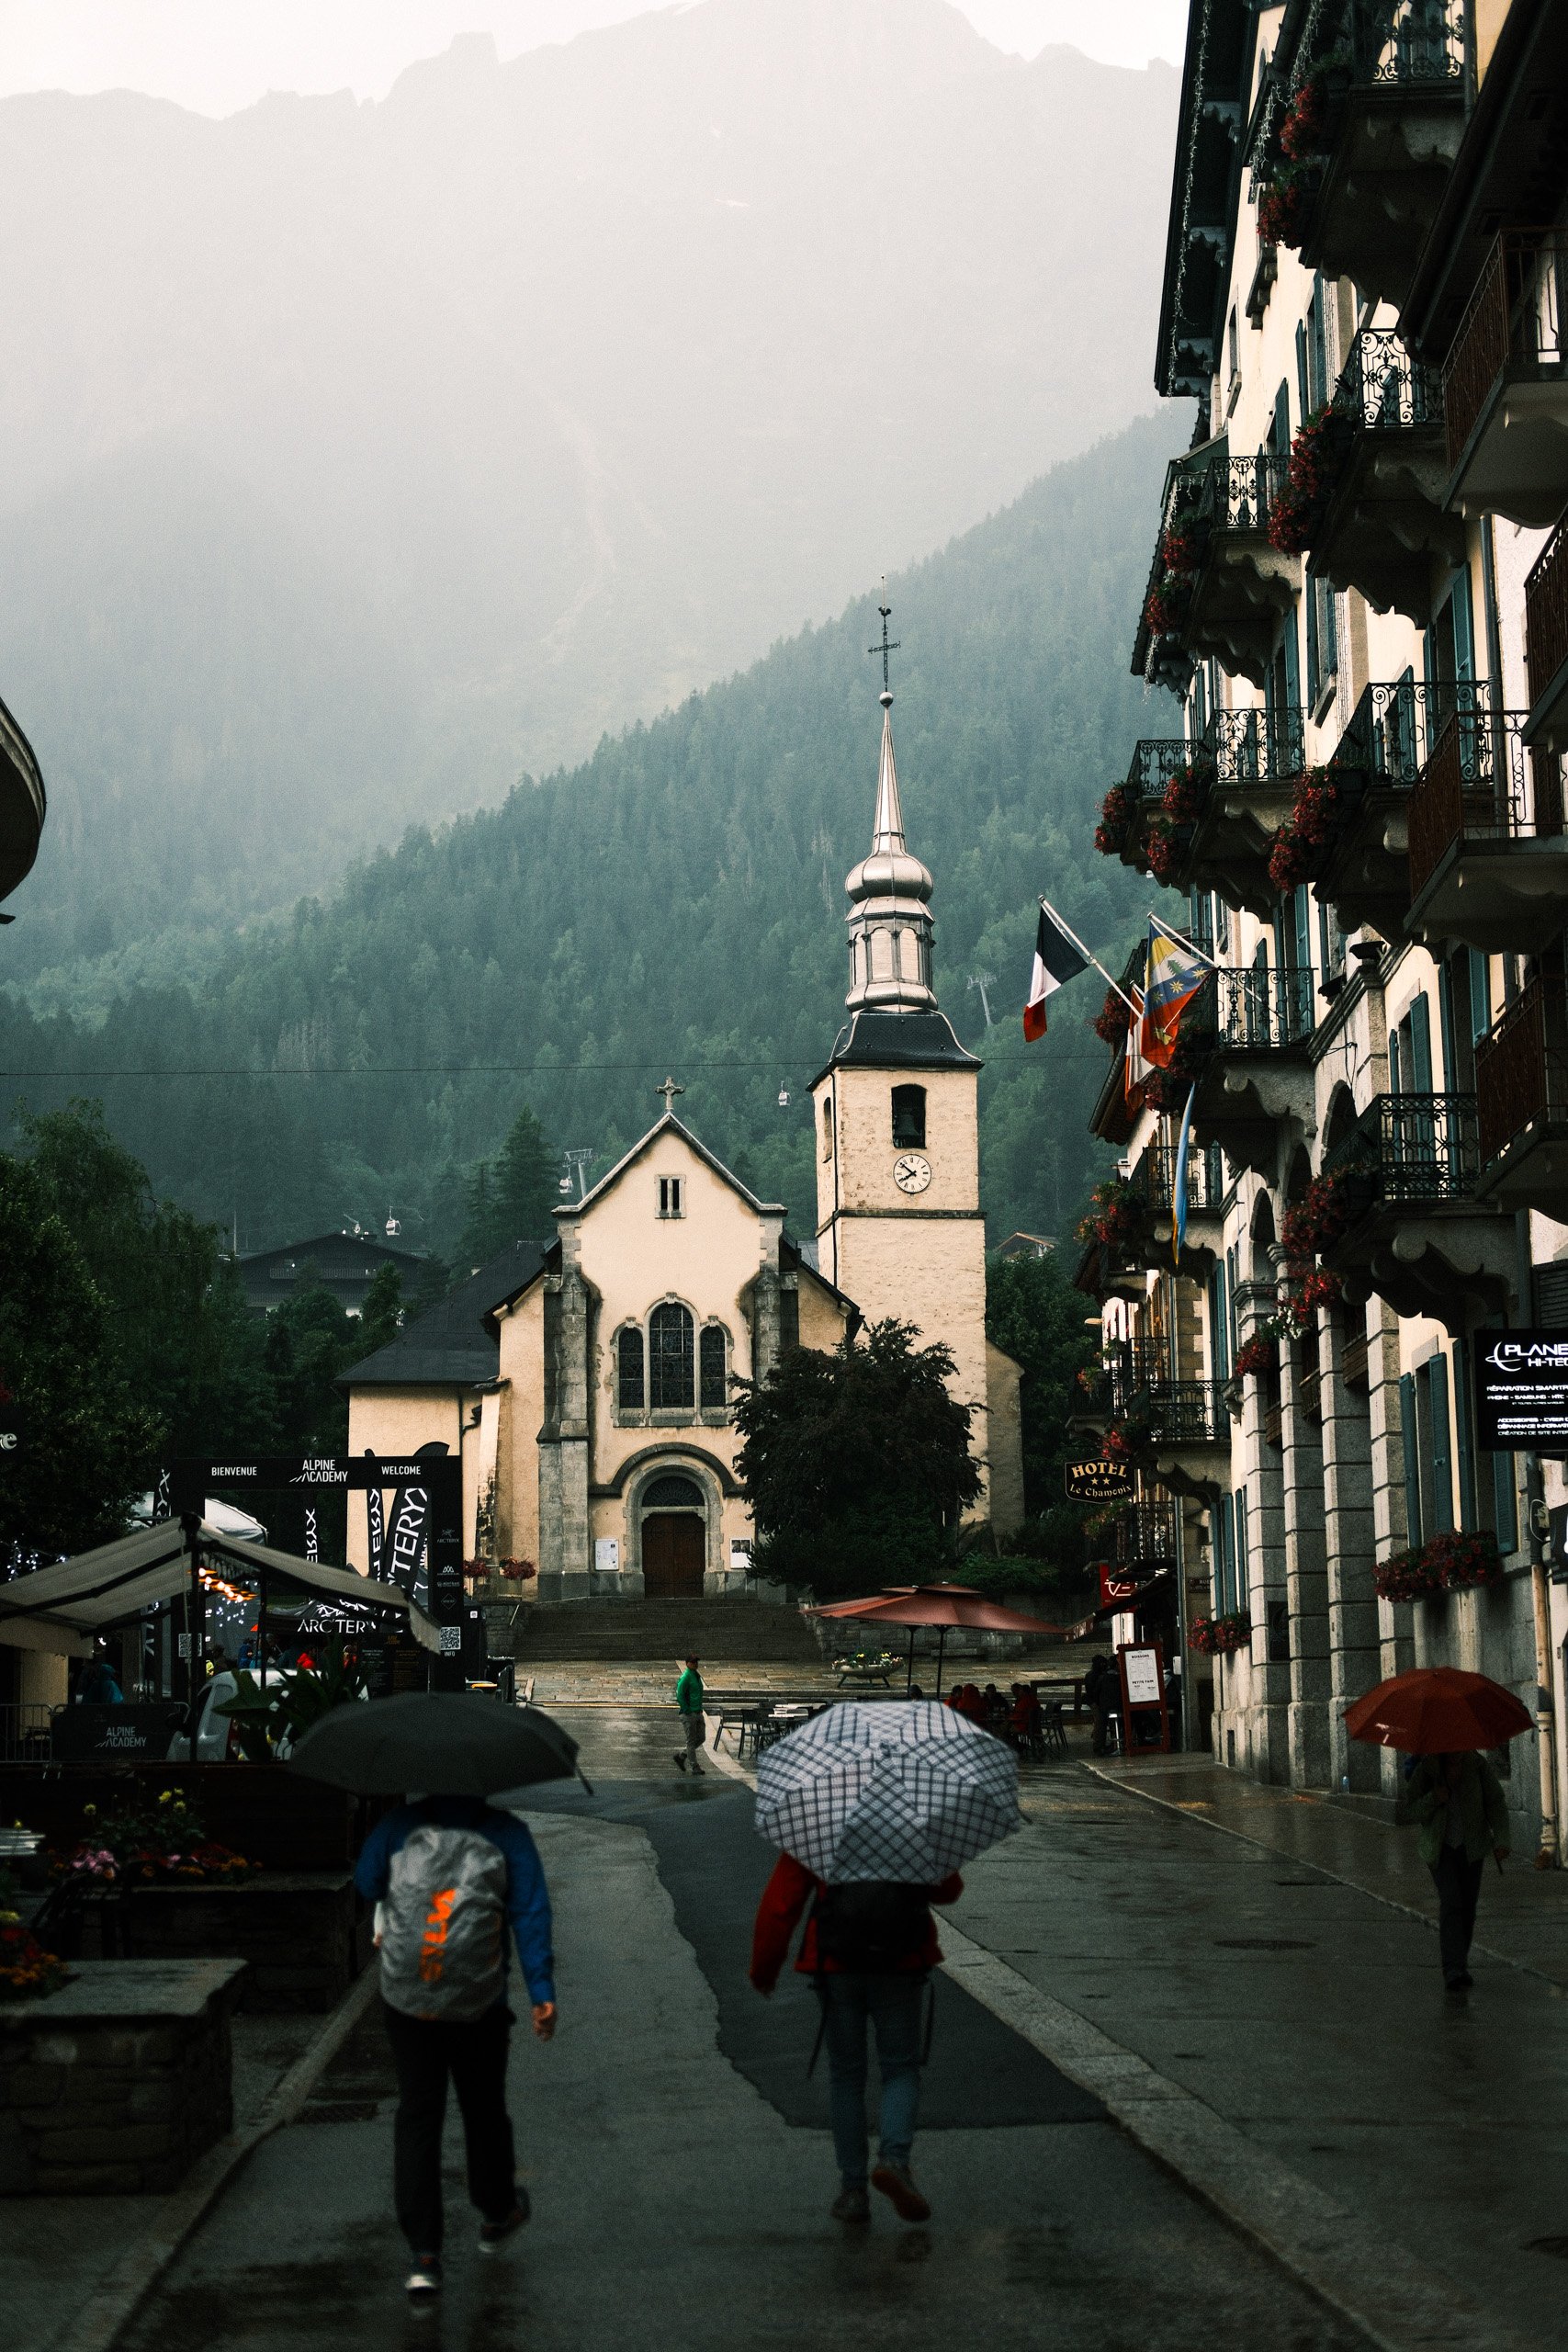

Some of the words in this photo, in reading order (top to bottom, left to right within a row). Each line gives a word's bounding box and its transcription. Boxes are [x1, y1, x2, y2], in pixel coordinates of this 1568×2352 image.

[302, 1459, 336, 1471] ALPINE
[381, 1465, 422, 1476] WELCOME
[1071, 1462, 1127, 1479] HOTEL
[211, 1466, 257, 1476] BIENVENUE
[300, 1471, 349, 1483] ACADEMY
[1069, 1483, 1082, 1495] Le
[1085, 1484, 1133, 1498] Chamonix
[106, 1726, 136, 1736] ALPINE
[105, 1736, 147, 1747] ACADEMY
